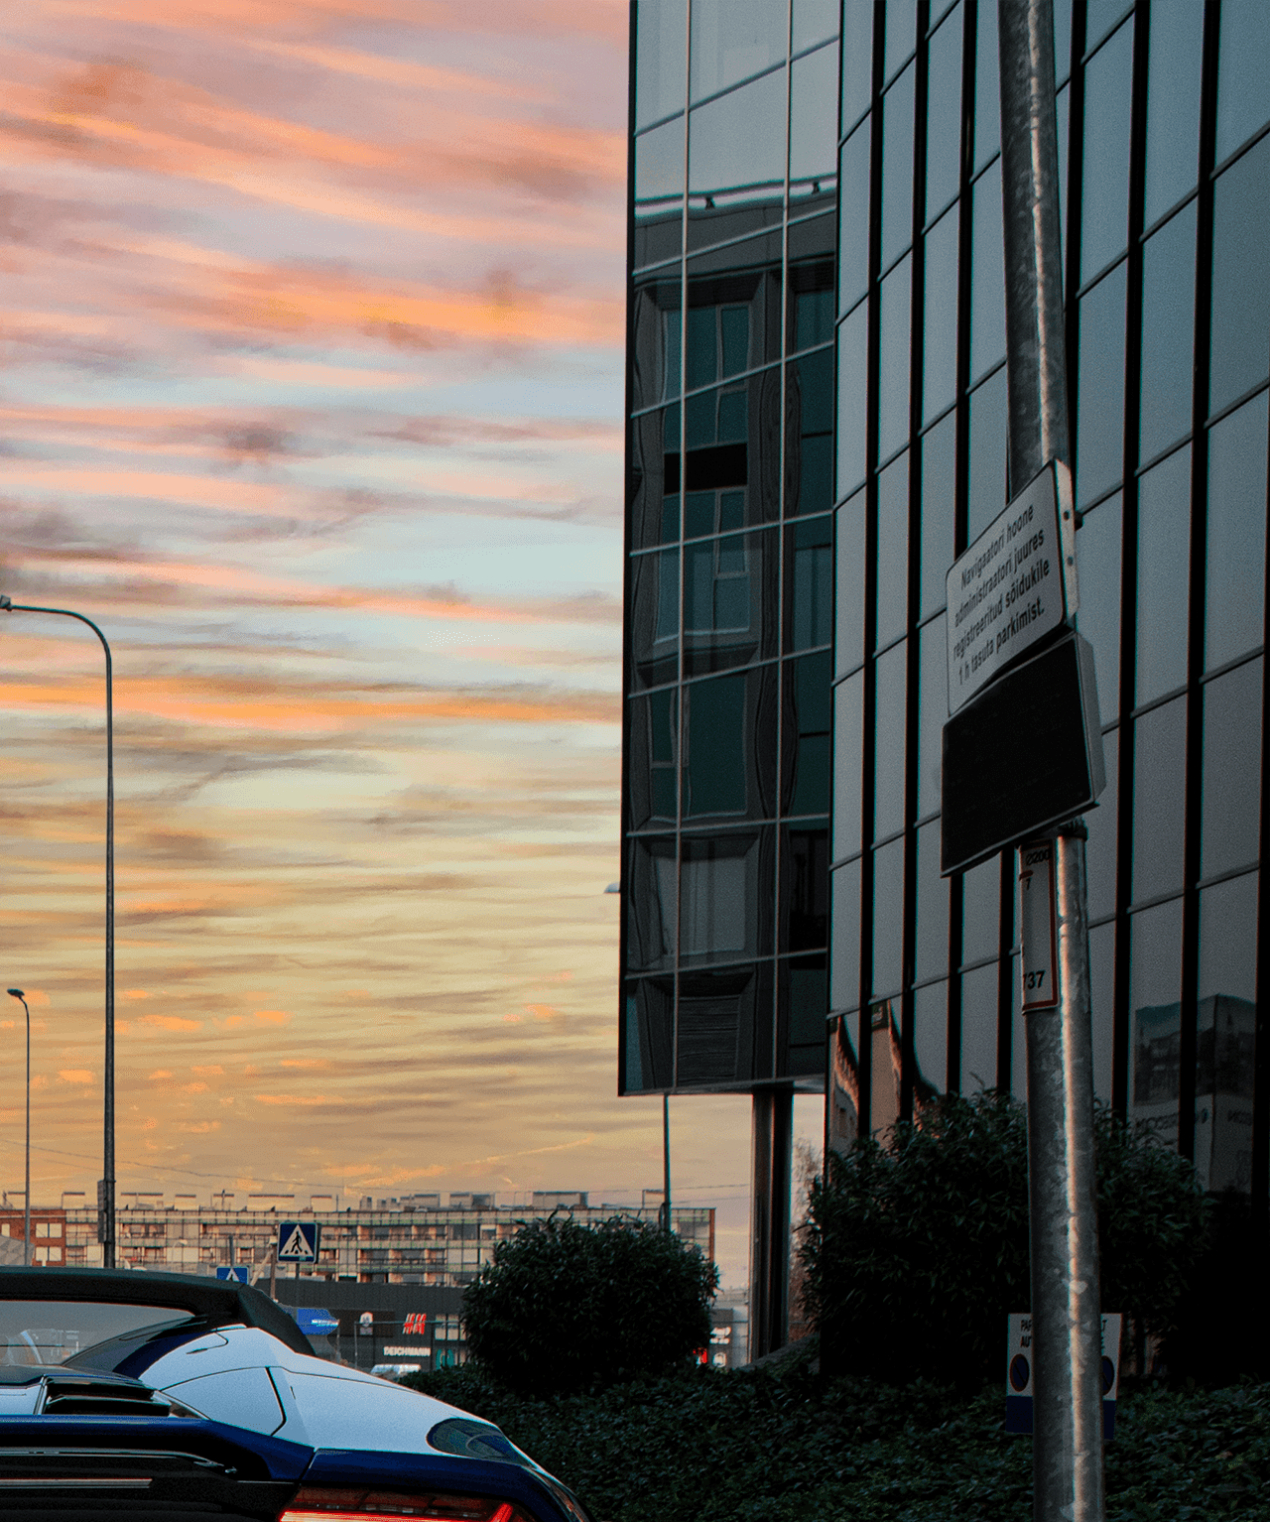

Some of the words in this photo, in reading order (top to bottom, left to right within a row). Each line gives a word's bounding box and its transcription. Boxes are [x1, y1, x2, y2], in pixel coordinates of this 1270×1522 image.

[955, 554, 1012, 627] administraatori
[1014, 528, 1045, 571] juures
[961, 529, 1005, 591] Navigaatori
[1007, 503, 1034, 545] hoone
[953, 594, 1003, 662] registreeritud
[1005, 559, 1050, 608] sõidukile
[958, 665, 964, 685] 1
[965, 659, 970, 680] h
[971, 639, 994, 674] tasuta
[996, 597, 1045, 650] parkimist.
